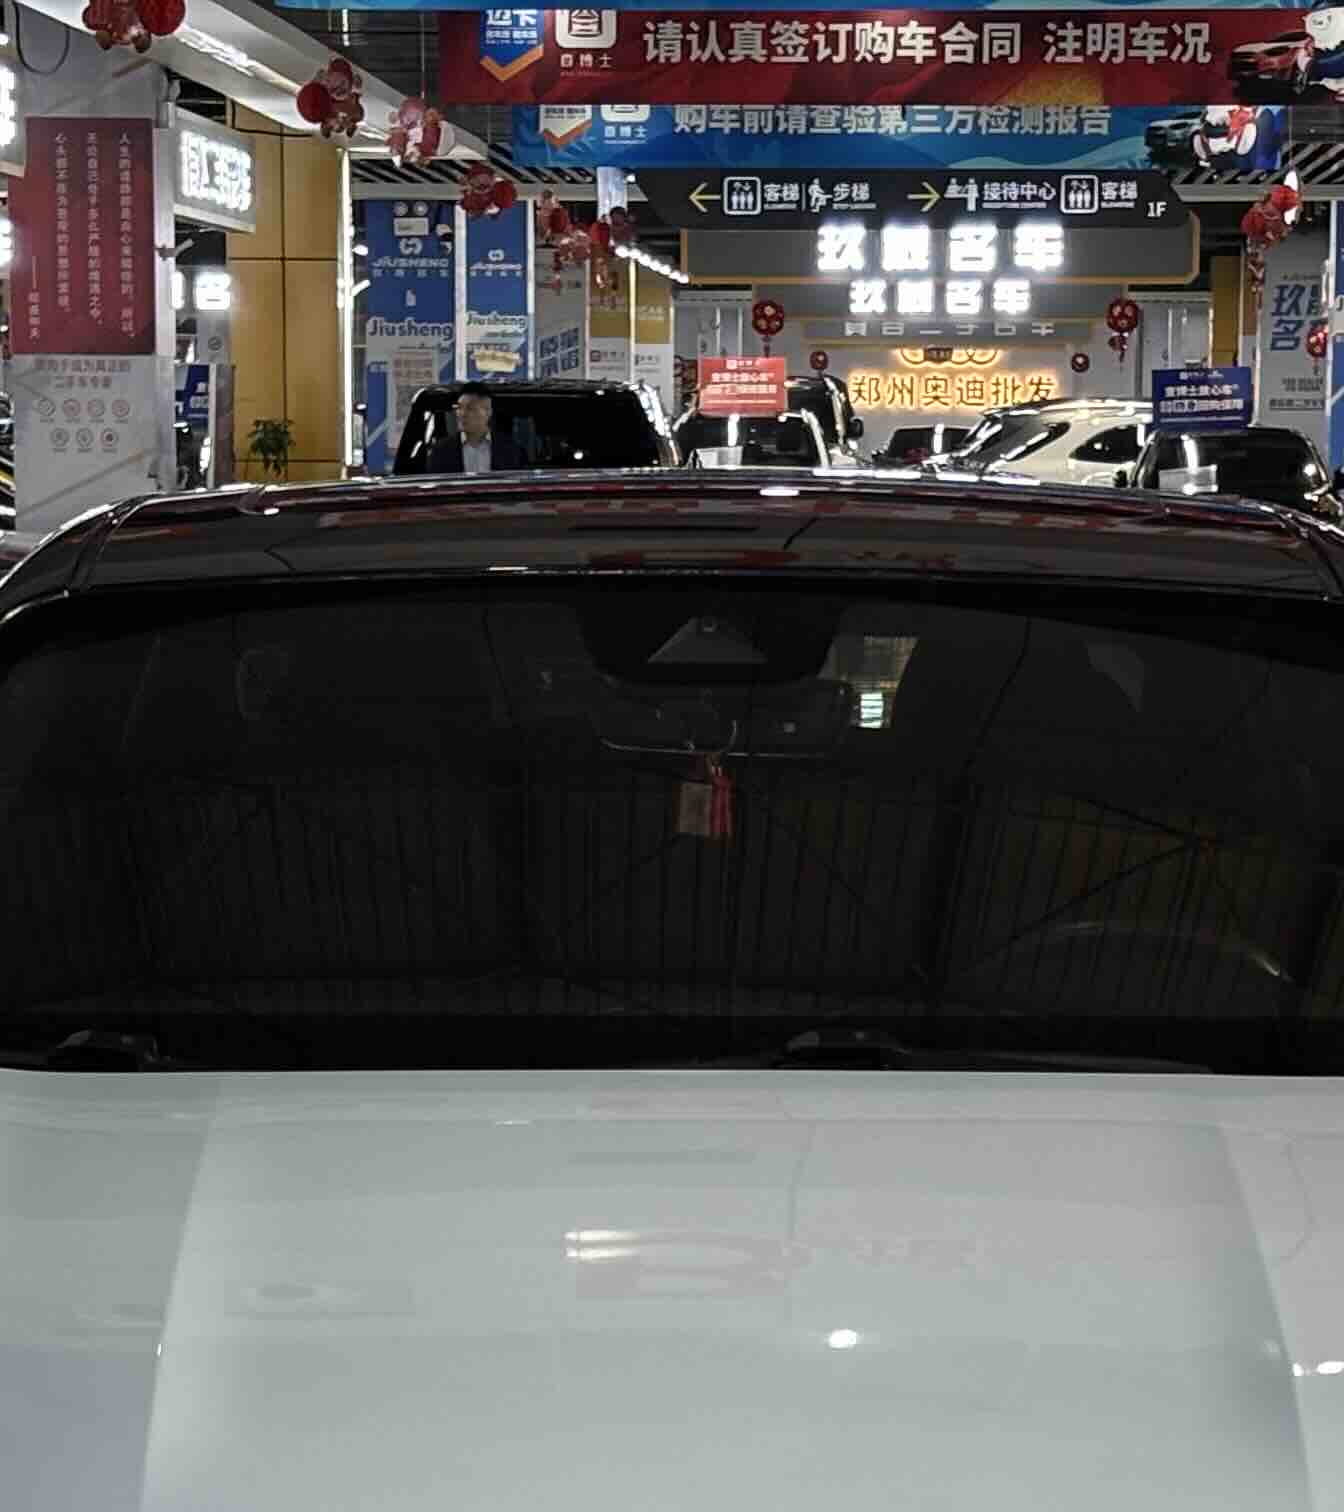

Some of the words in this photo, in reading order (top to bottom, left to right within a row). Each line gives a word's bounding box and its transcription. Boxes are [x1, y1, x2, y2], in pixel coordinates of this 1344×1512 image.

[643, 20, 1022, 64] 请认真签订购车合同
[1042, 20, 1213, 64] 注明车况
[673, 105, 1112, 135] 购车前请查验第三方检测报告
[763, 183, 800, 202] 客梯
[832, 183, 871, 202] 步梯
[983, 182, 1057, 202] 接待中心
[1101, 181, 1139, 201] 客梯
[369, 317, 454, 341] Jiusheng
[854, 375, 1057, 406] 郑州奥迪批发
